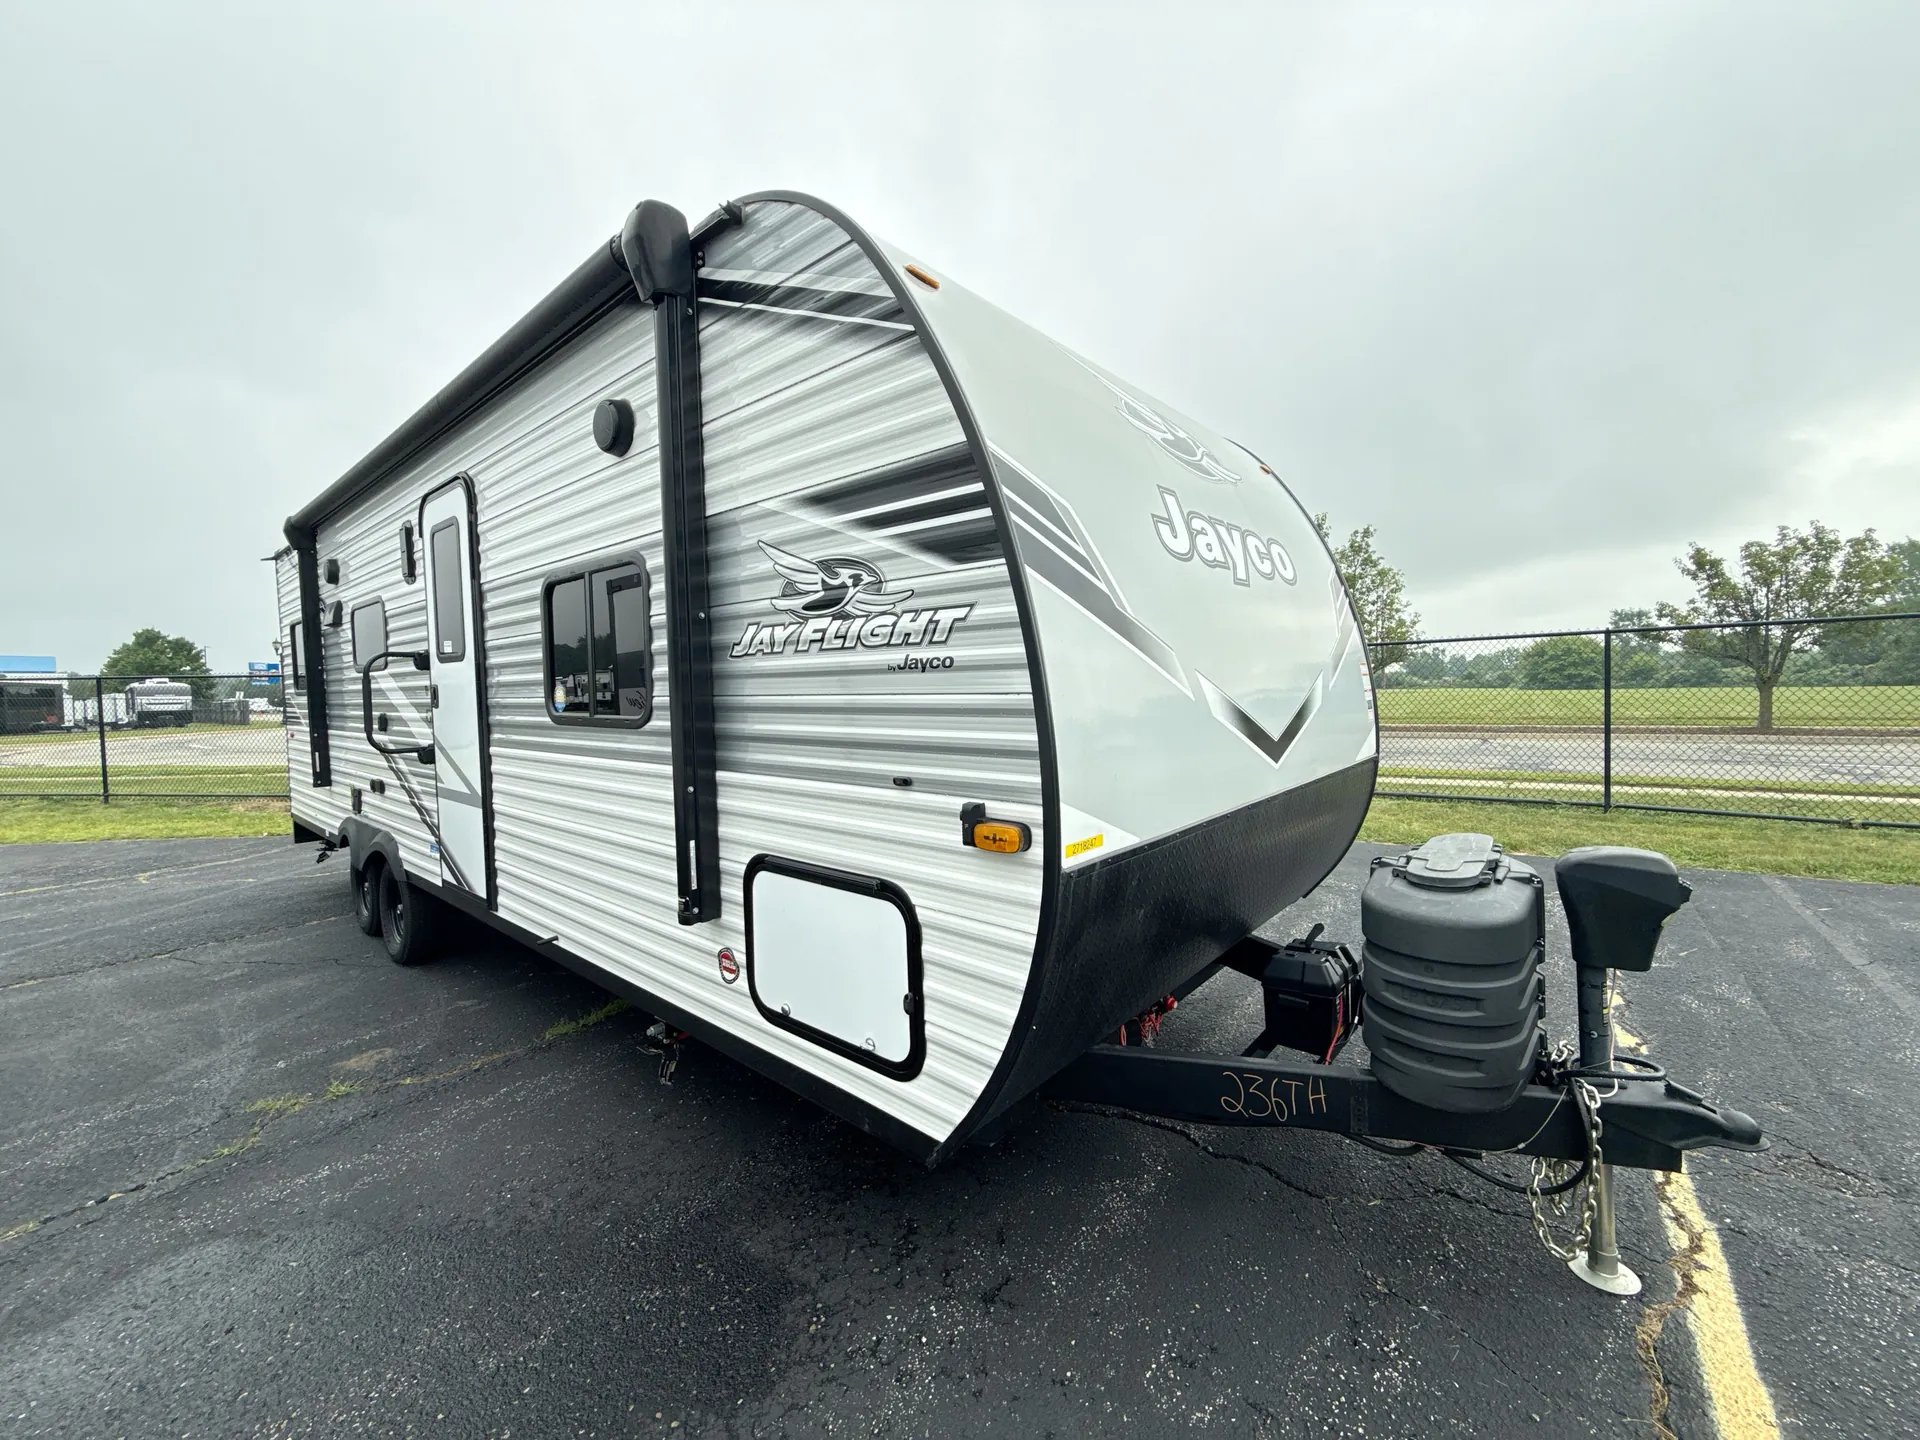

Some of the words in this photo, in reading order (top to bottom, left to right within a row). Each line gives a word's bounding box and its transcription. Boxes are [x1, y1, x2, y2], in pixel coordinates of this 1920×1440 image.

[1151, 484, 1298, 588] Jayco
[897, 654, 955, 673] Jayco
[1221, 1071, 1327, 1122] 236TH
